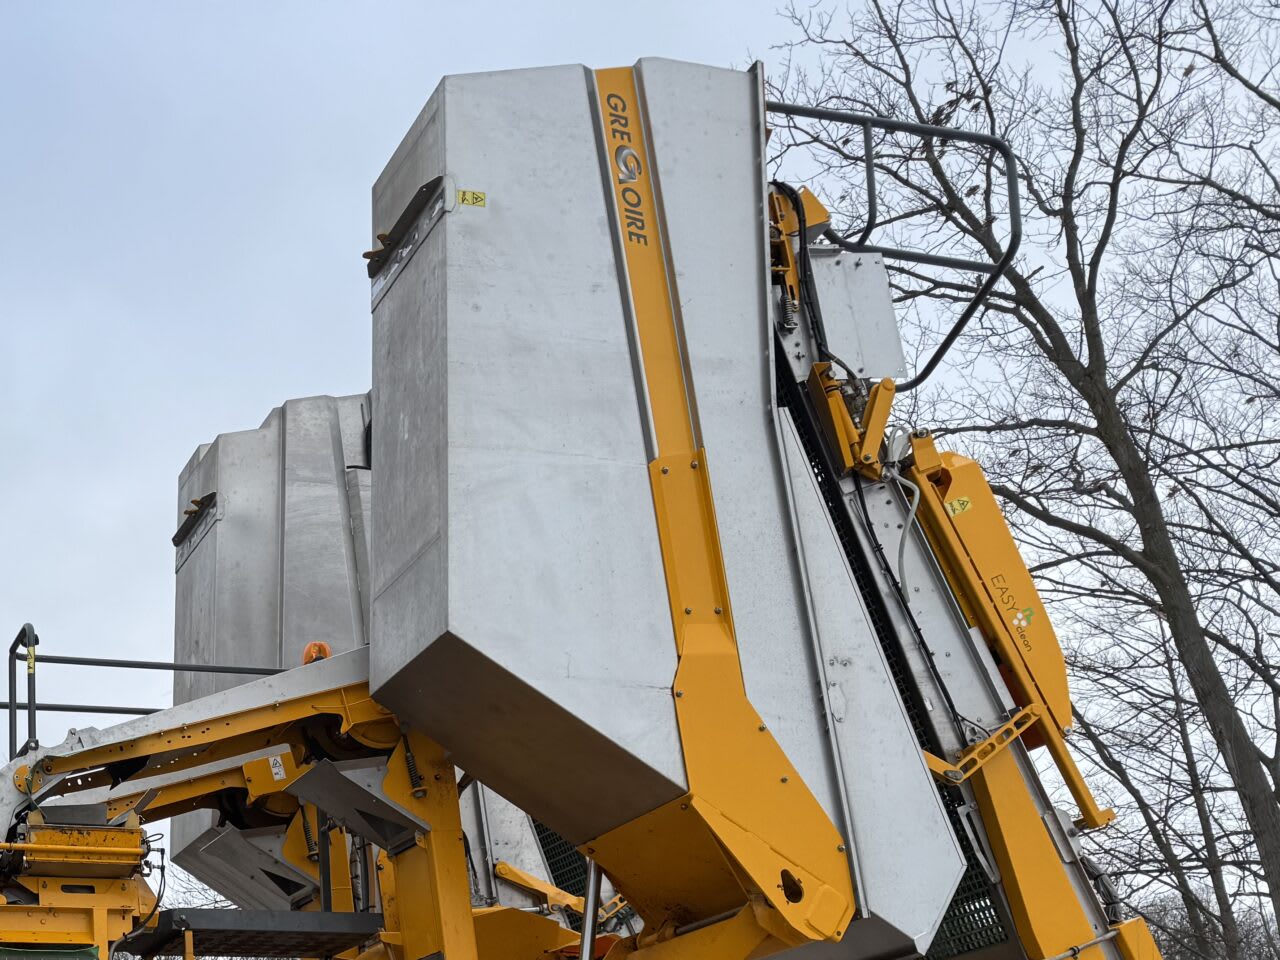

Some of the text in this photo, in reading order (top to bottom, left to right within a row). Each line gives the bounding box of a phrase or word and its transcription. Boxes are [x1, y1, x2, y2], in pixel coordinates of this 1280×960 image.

[606, 93, 648, 247] GREGOIRE
[990, 573, 1032, 652] EASY clean
